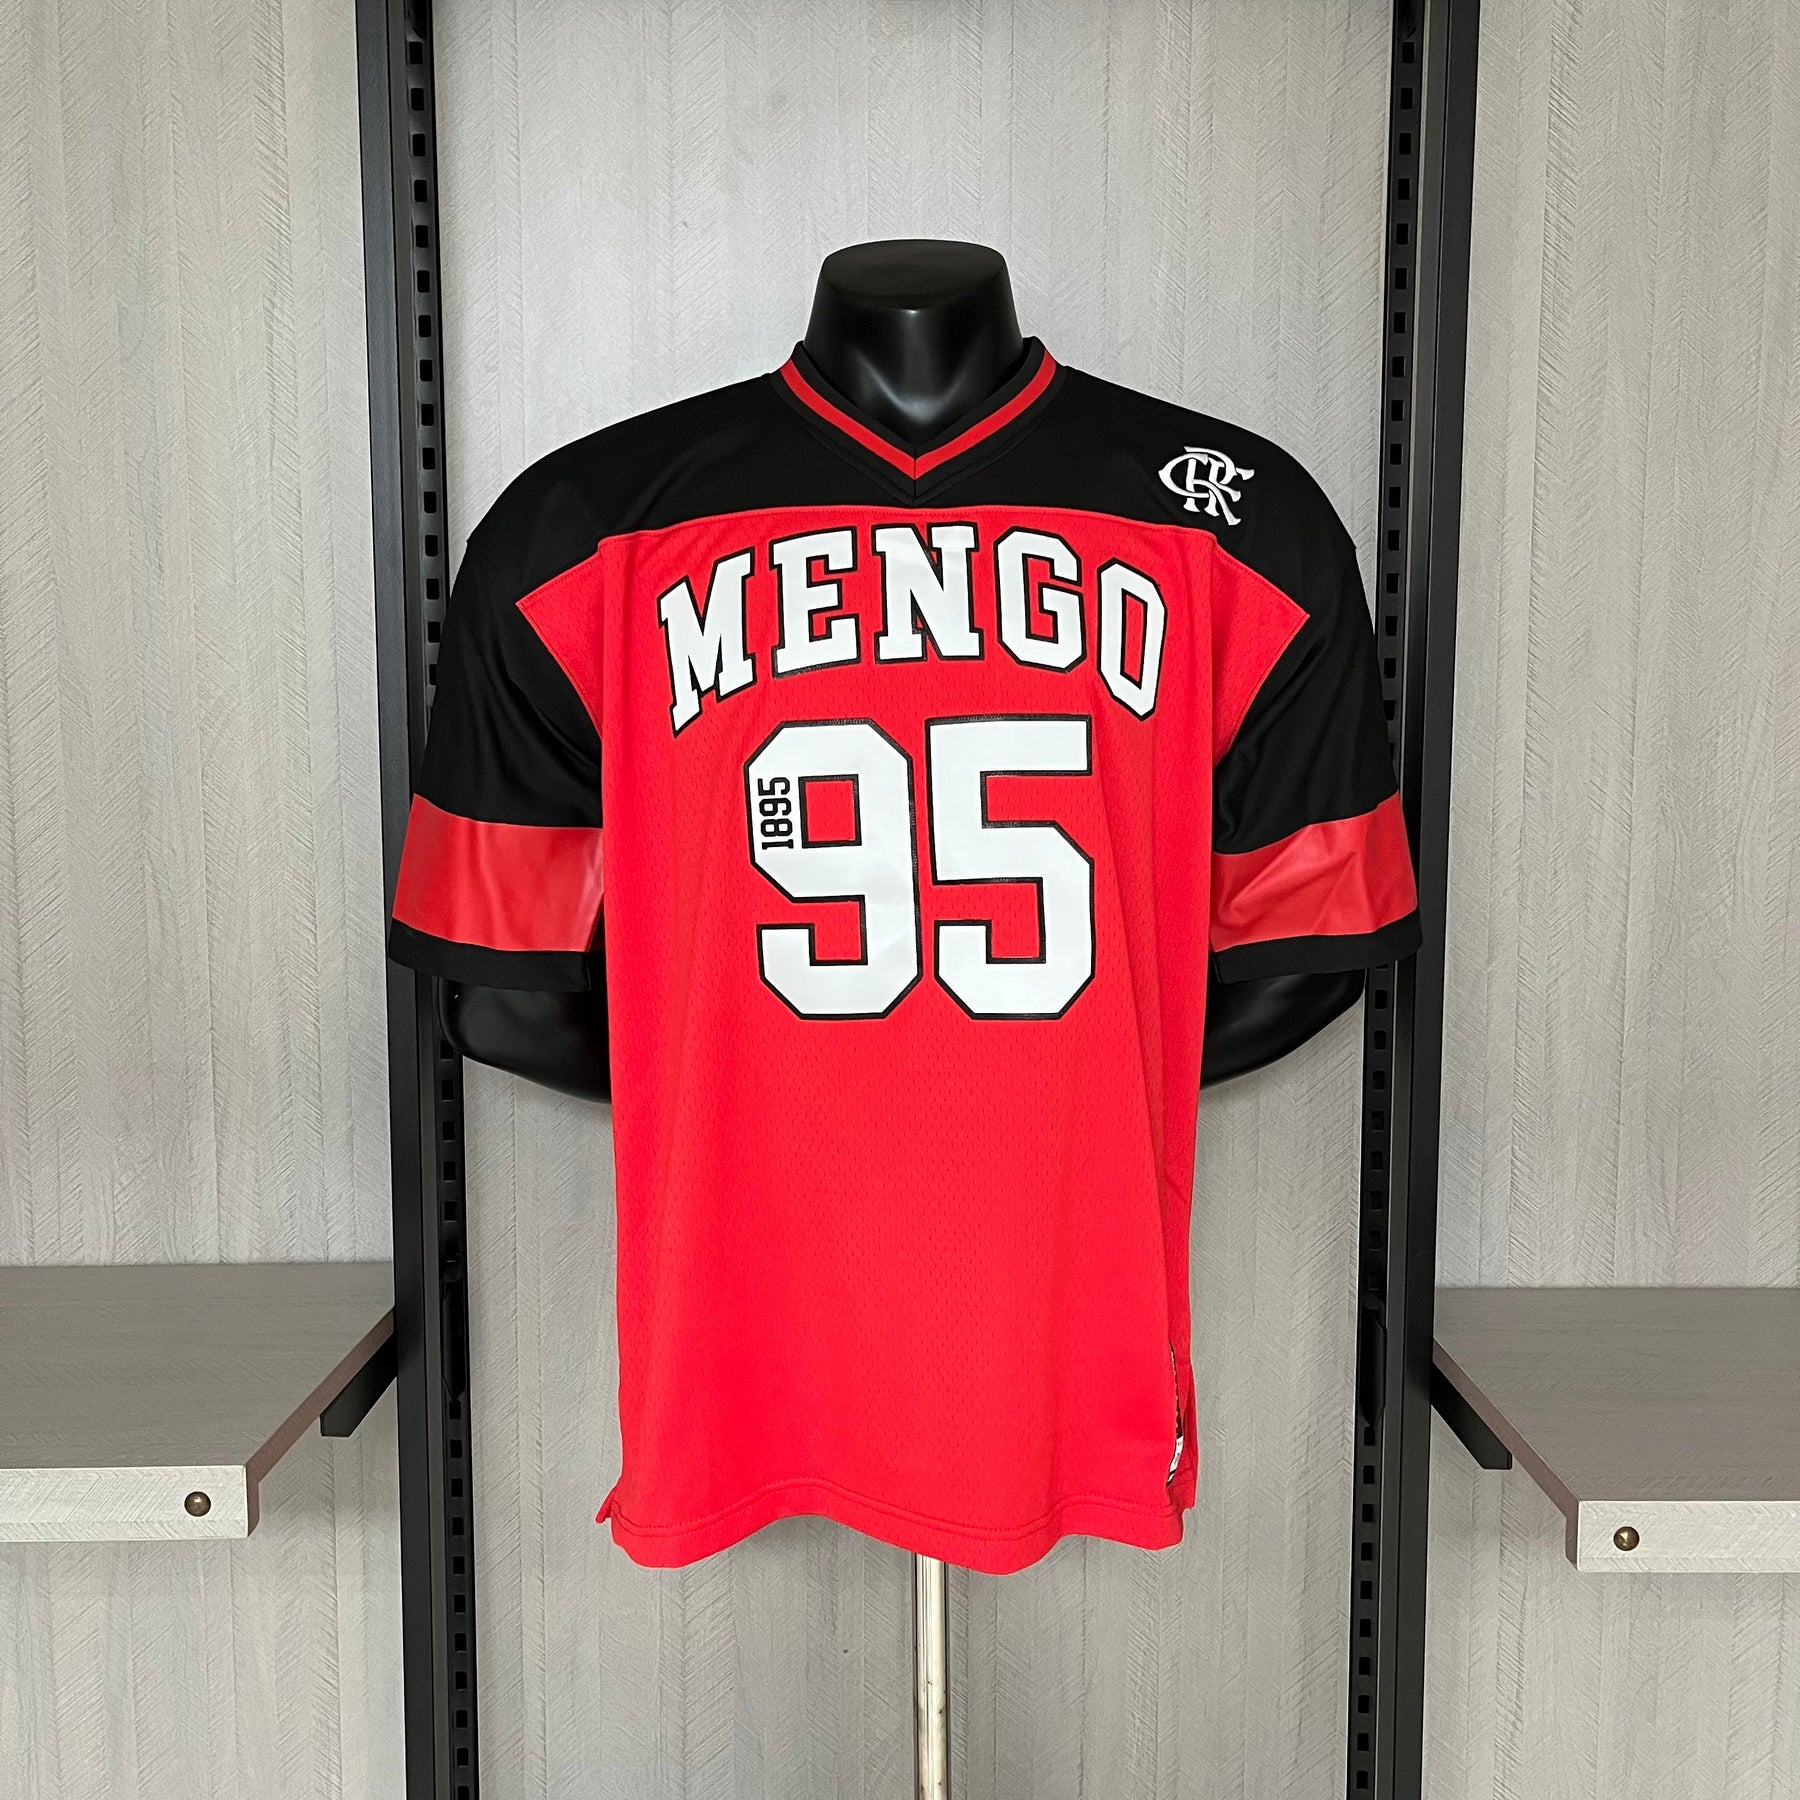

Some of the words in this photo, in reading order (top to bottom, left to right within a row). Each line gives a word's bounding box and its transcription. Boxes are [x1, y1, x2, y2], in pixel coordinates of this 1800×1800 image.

[657, 521, 1167, 738] MENGO
[744, 714, 1096, 1020] 95
[758, 776, 794, 850] 1895
